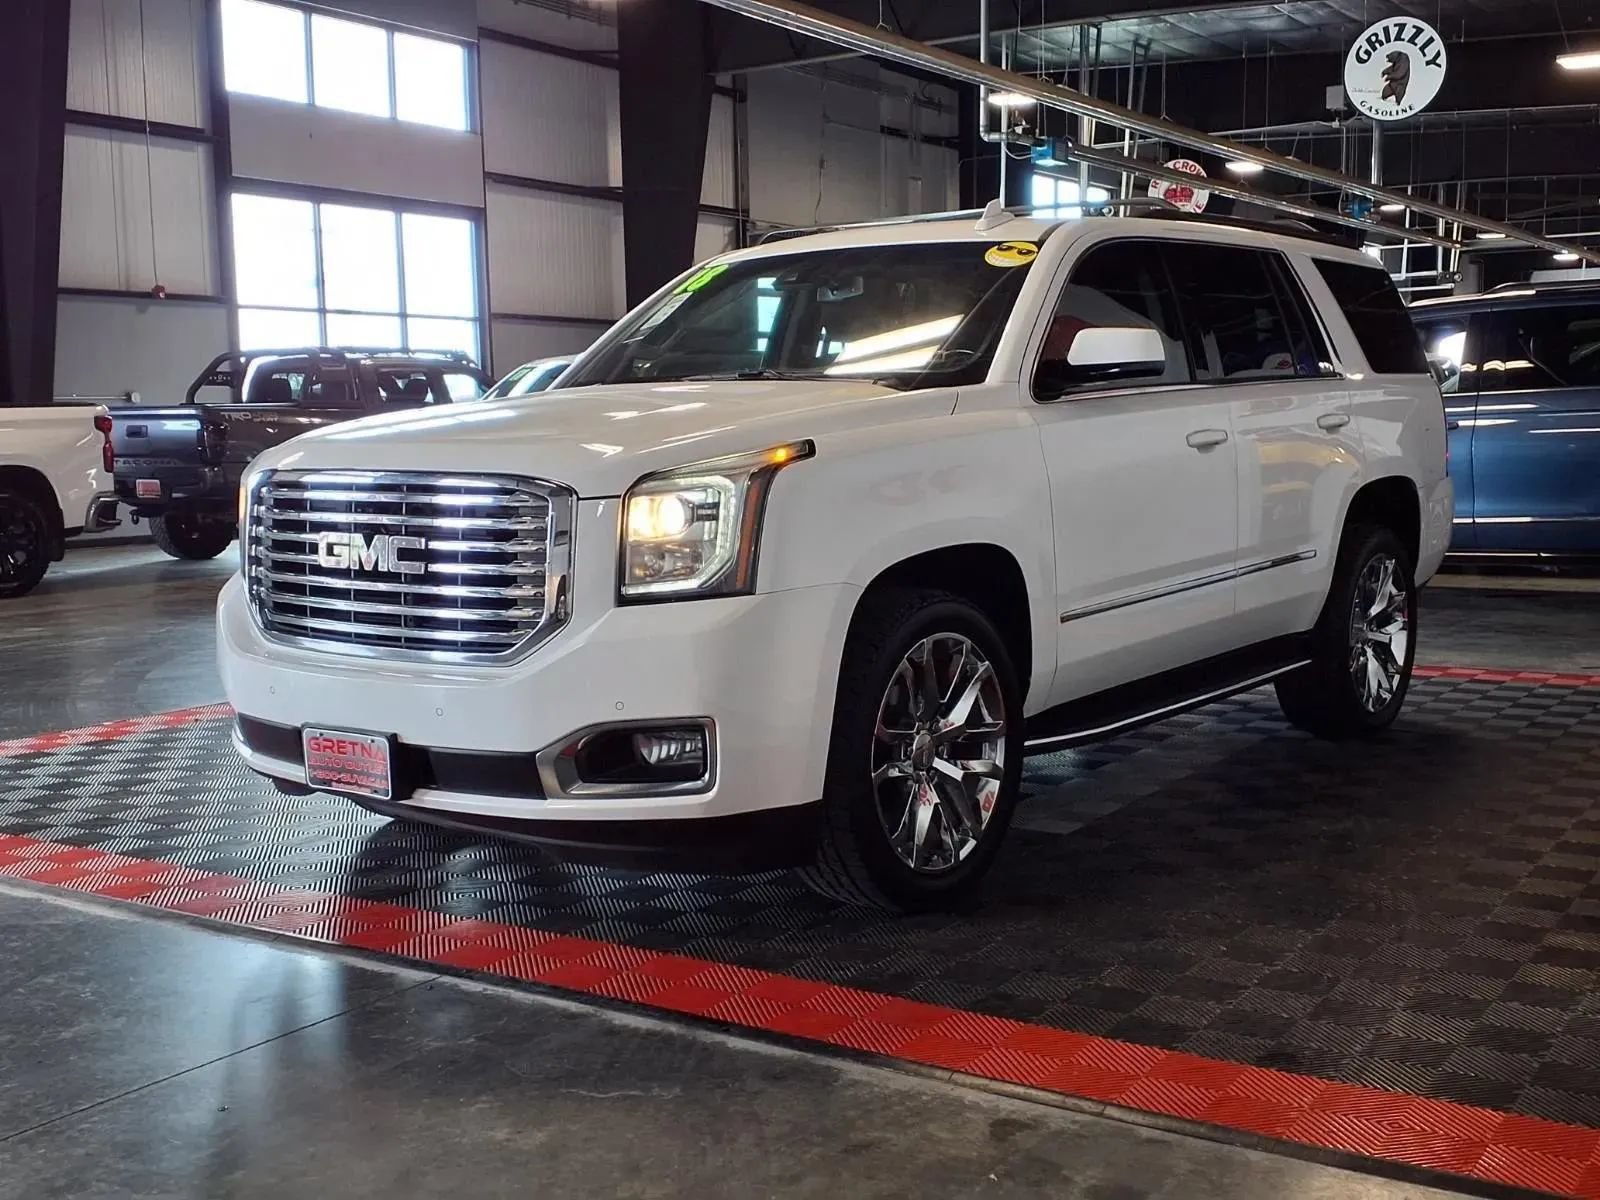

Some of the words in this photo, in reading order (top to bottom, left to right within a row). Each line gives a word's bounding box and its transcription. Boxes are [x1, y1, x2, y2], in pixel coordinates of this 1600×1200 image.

[1355, 23, 1442, 68] GRIZZLY
[1360, 101, 1415, 117] GASOLINE
[220, 411, 252, 421] TRD
[318, 531, 426, 574] GMC
